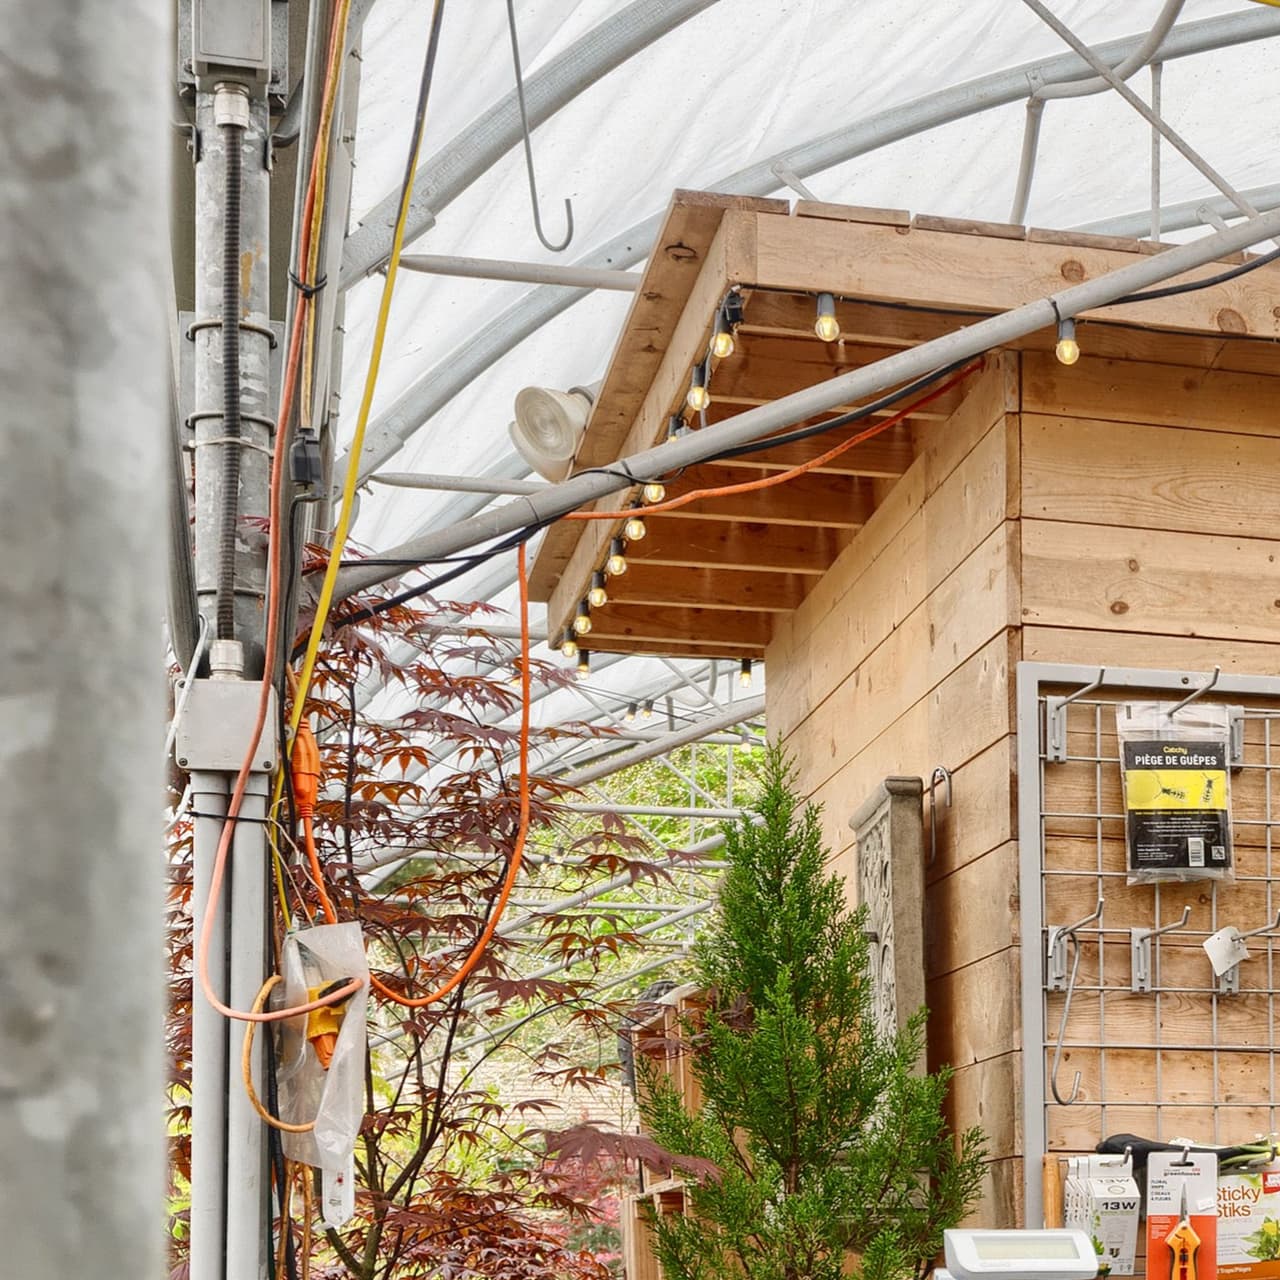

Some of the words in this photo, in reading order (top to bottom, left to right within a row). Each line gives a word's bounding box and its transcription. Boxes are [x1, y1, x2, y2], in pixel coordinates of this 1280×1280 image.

[1134, 753, 1164, 766] PIÈGE
[1165, 755, 1178, 765] DE
[1180, 754, 1217, 766] GUÊPES
[1102, 1201, 1137, 1210] 13W
